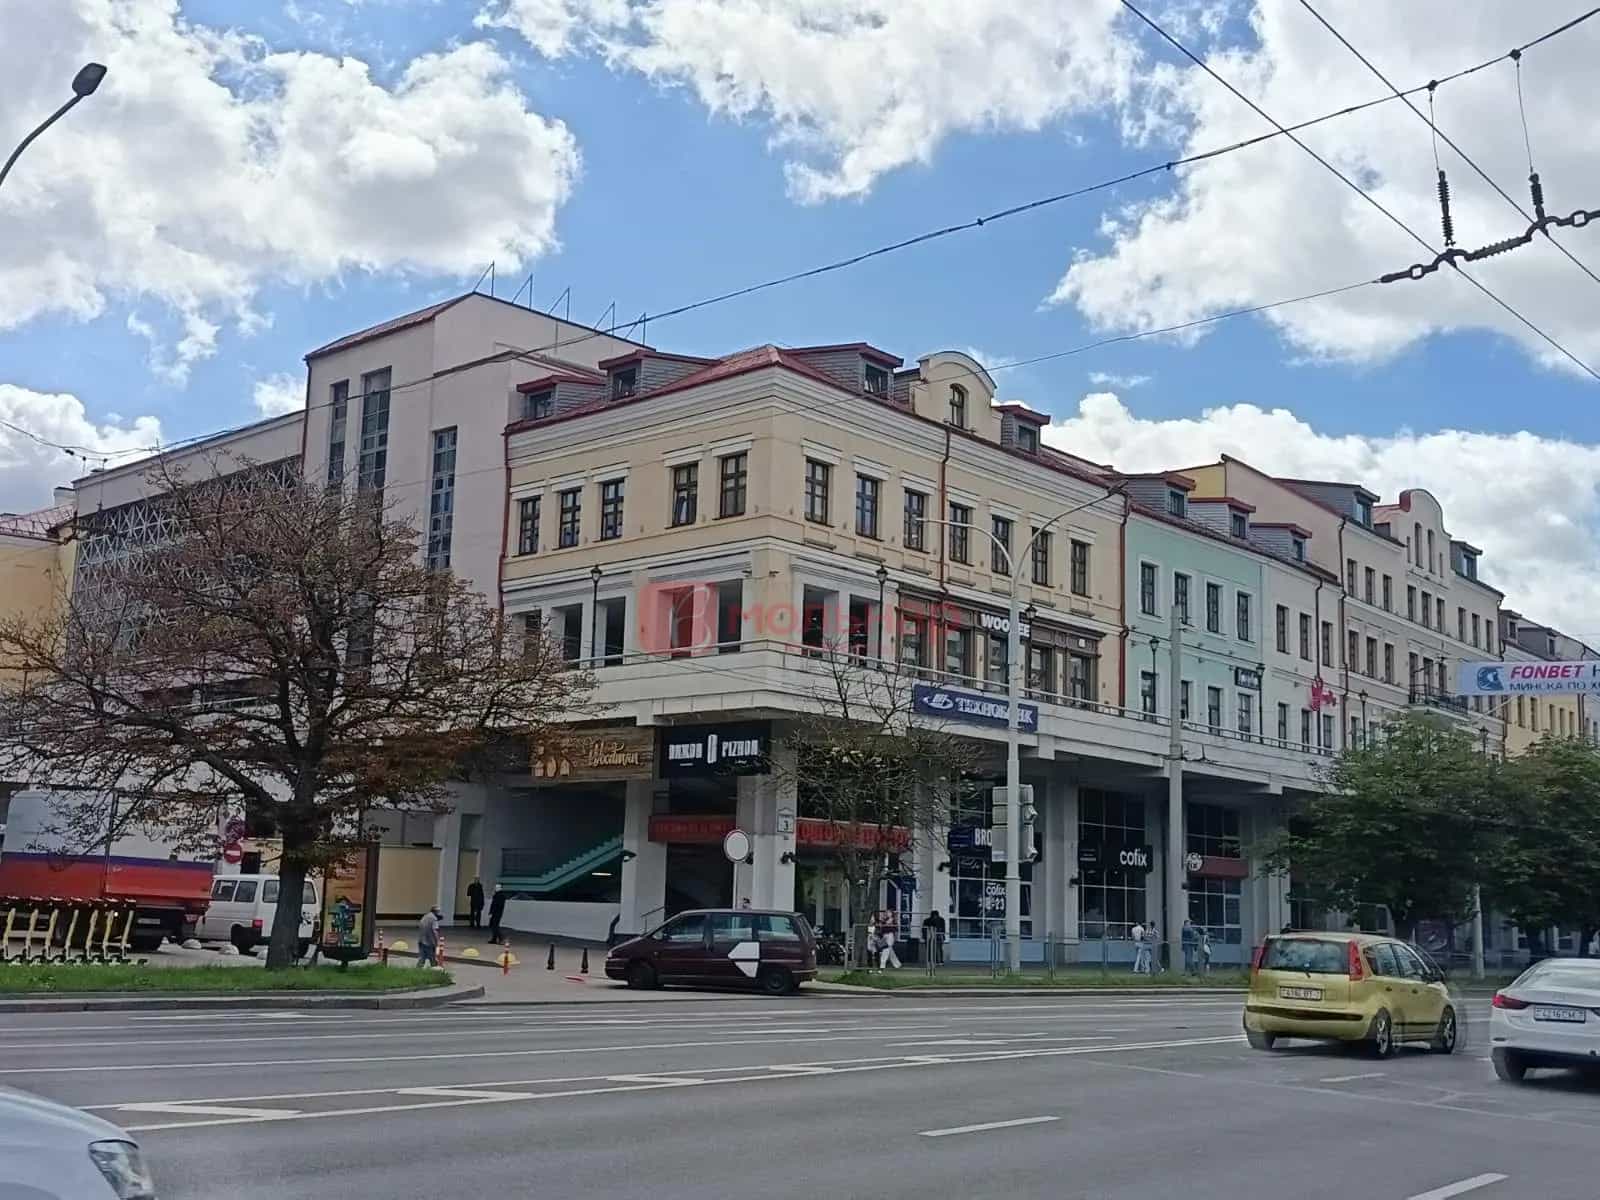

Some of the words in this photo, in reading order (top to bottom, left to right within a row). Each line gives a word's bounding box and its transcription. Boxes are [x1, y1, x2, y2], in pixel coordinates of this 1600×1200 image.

[1510, 664, 1585, 680] FONBET
[1509, 681, 1563, 691] МИНСКА
[1567, 681, 1586, 691] ПО
[954, 697, 1034, 724] ТЕХНОБНК
[1119, 848, 1148, 867] cofix
